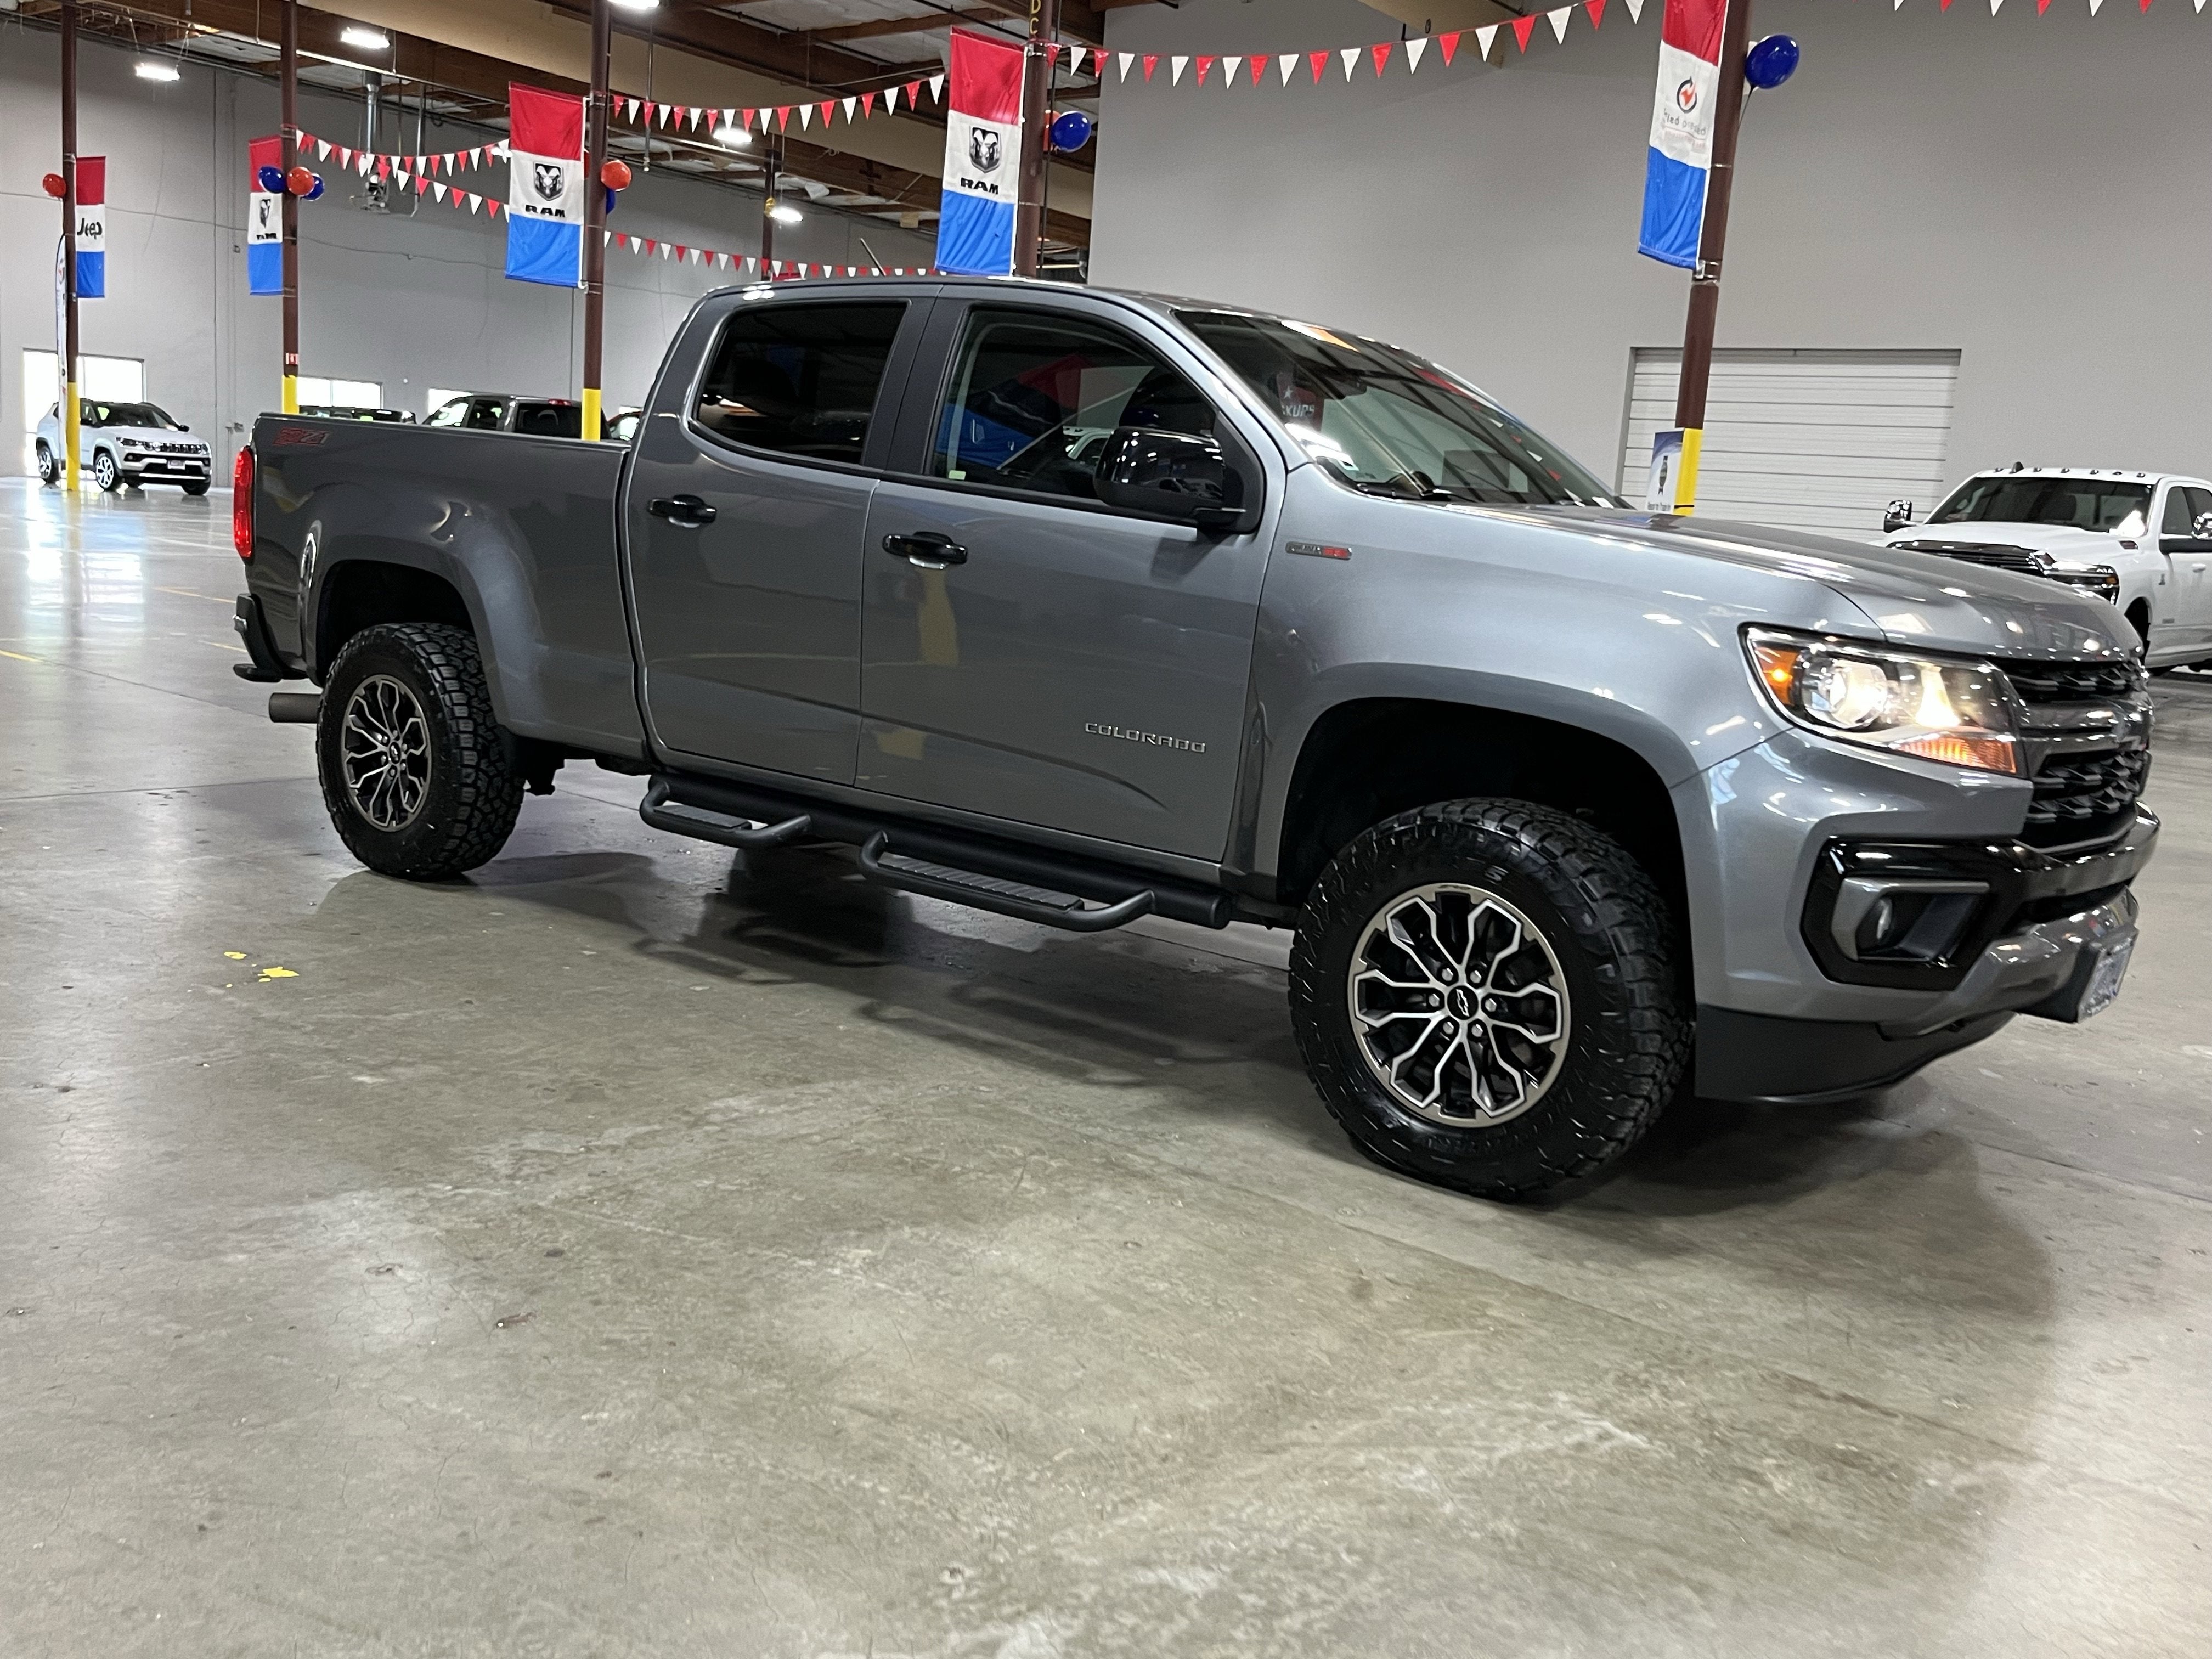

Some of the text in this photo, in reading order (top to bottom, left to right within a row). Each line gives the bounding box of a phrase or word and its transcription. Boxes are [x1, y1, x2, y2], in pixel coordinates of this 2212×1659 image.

[961, 177, 998, 195] RAM
[526, 204, 565, 217] RAM
[1085, 723, 1206, 753] COLORADO
